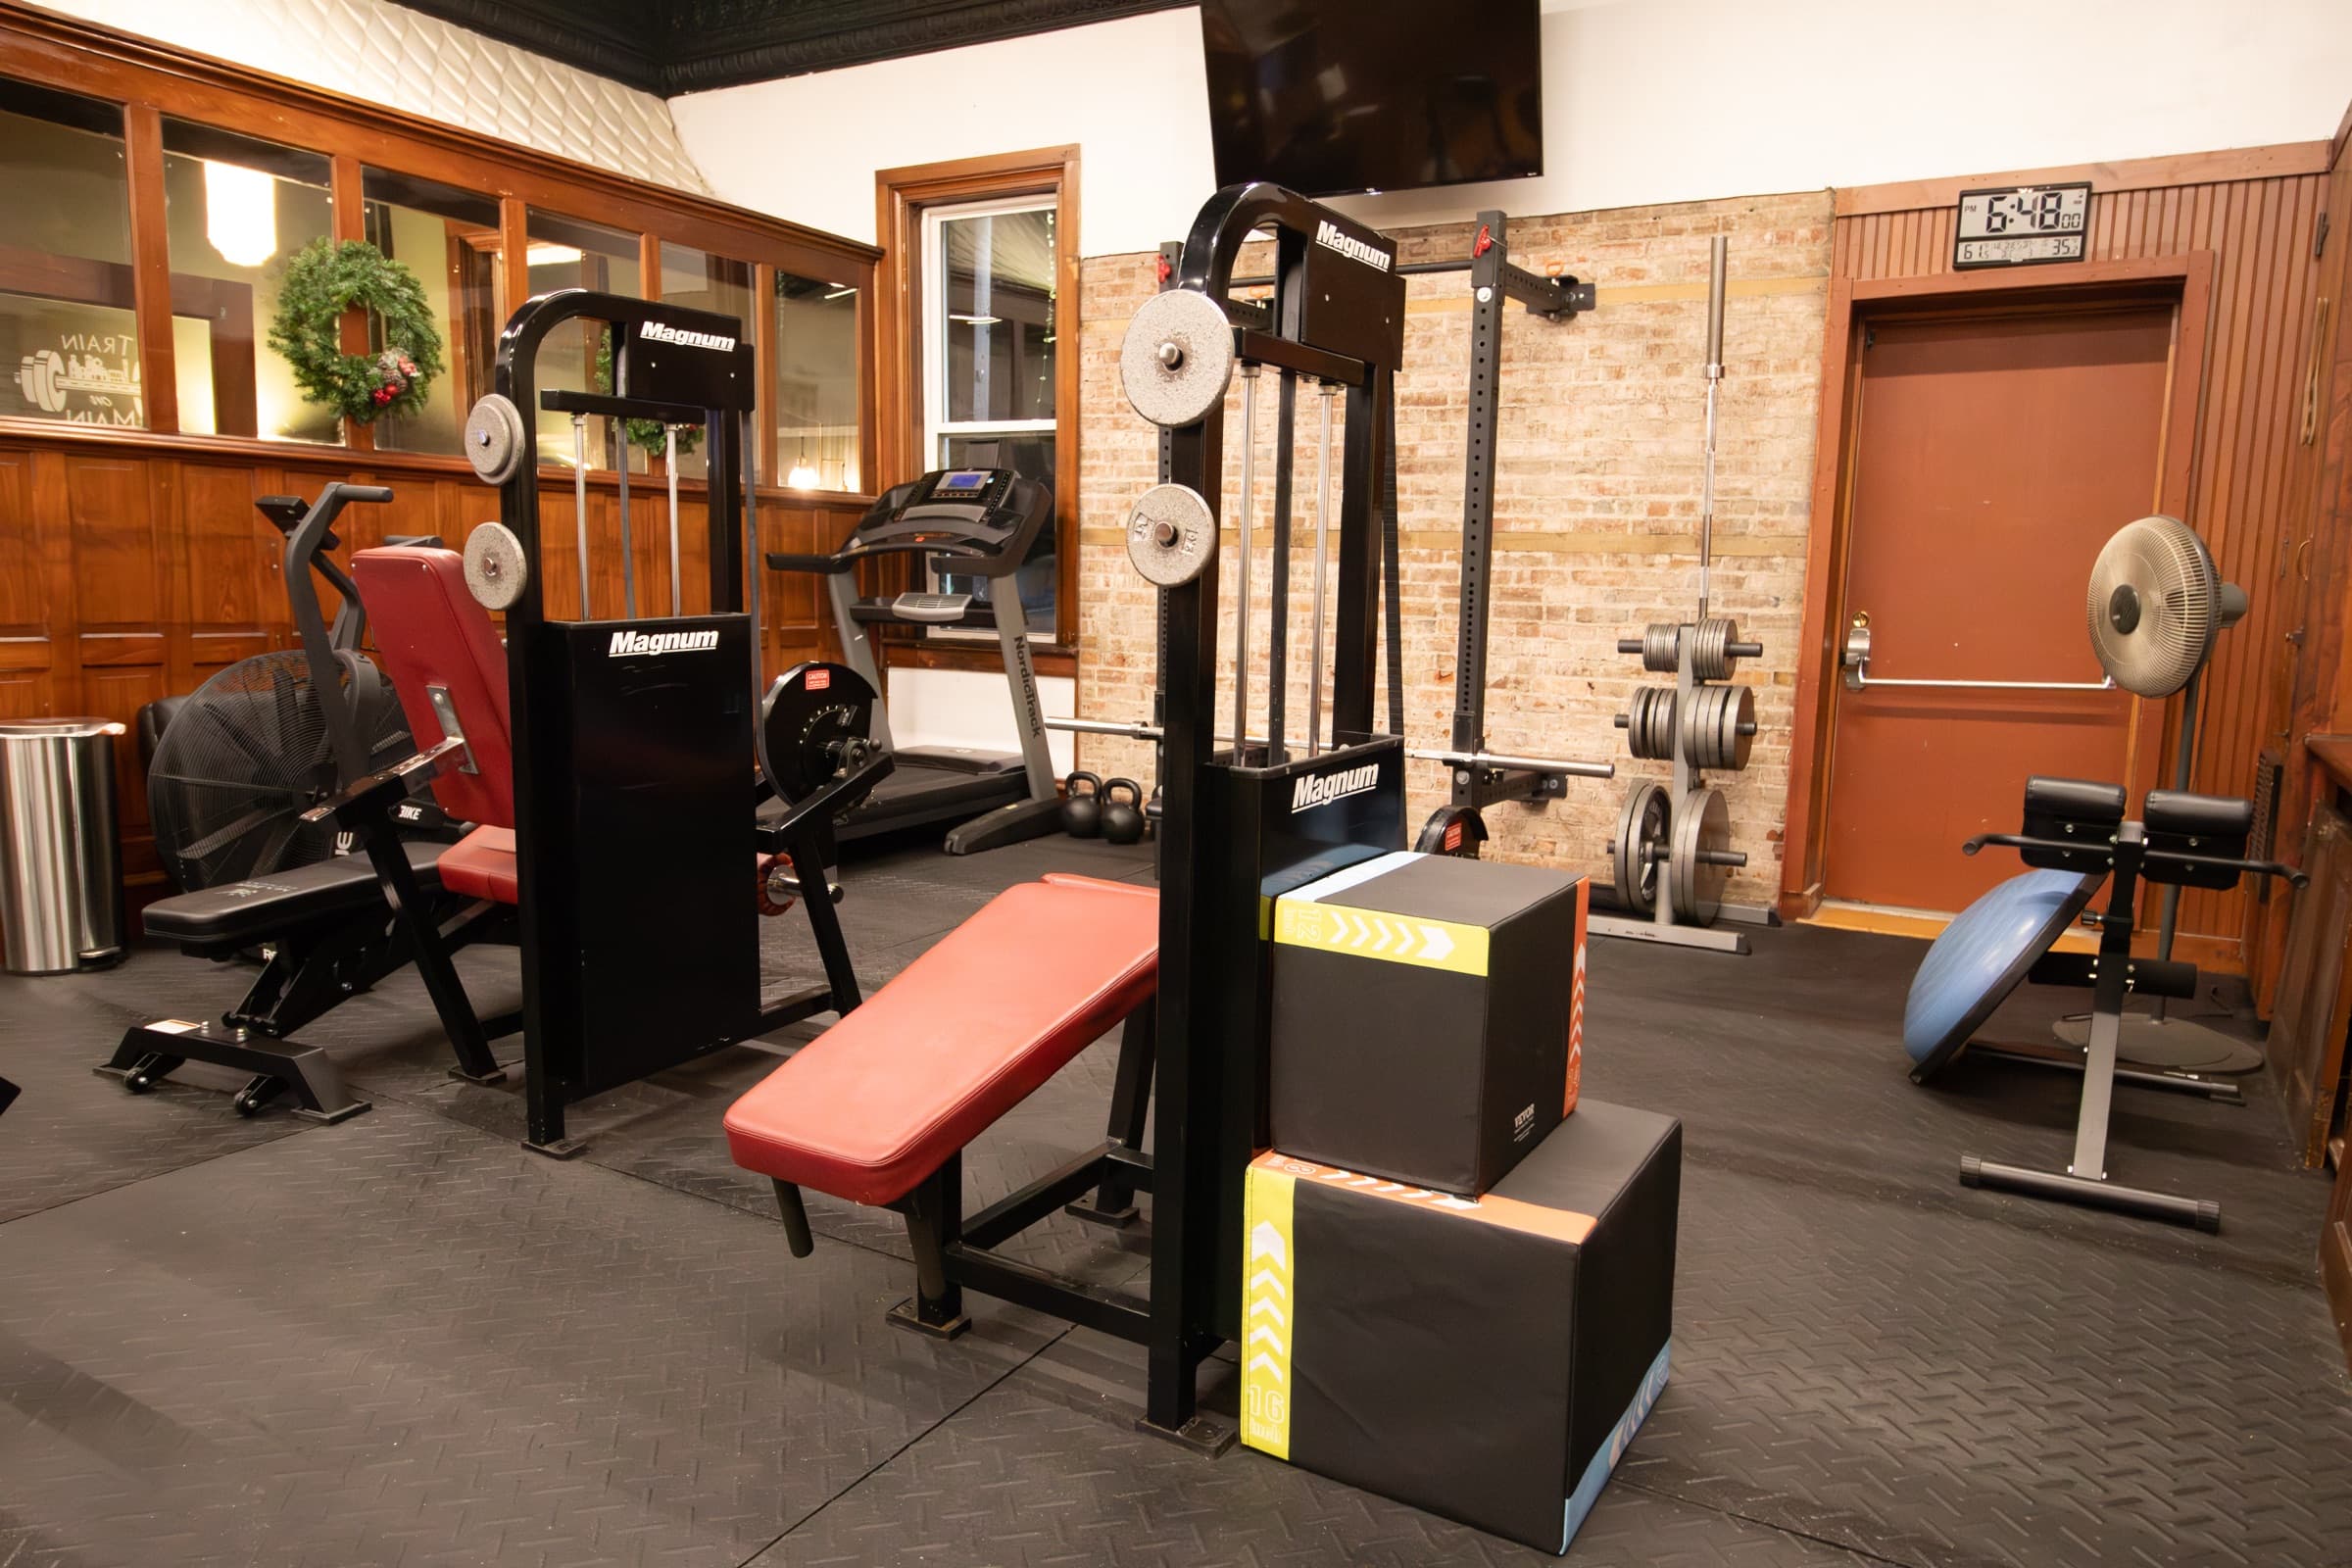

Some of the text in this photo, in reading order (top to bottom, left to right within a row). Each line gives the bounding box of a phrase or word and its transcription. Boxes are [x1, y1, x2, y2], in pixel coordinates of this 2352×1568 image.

[1985, 192, 2063, 233] 6:48
[2061, 213, 2082, 229] 00
[1315, 220, 1391, 272] Magnum
[640, 320, 736, 352] Magnum
[609, 630, 719, 658] Magnum
[1014, 635, 1041, 739] NordicTrack
[1291, 762, 1379, 813] Magnum
[1248, 1383, 1285, 1425] 16
